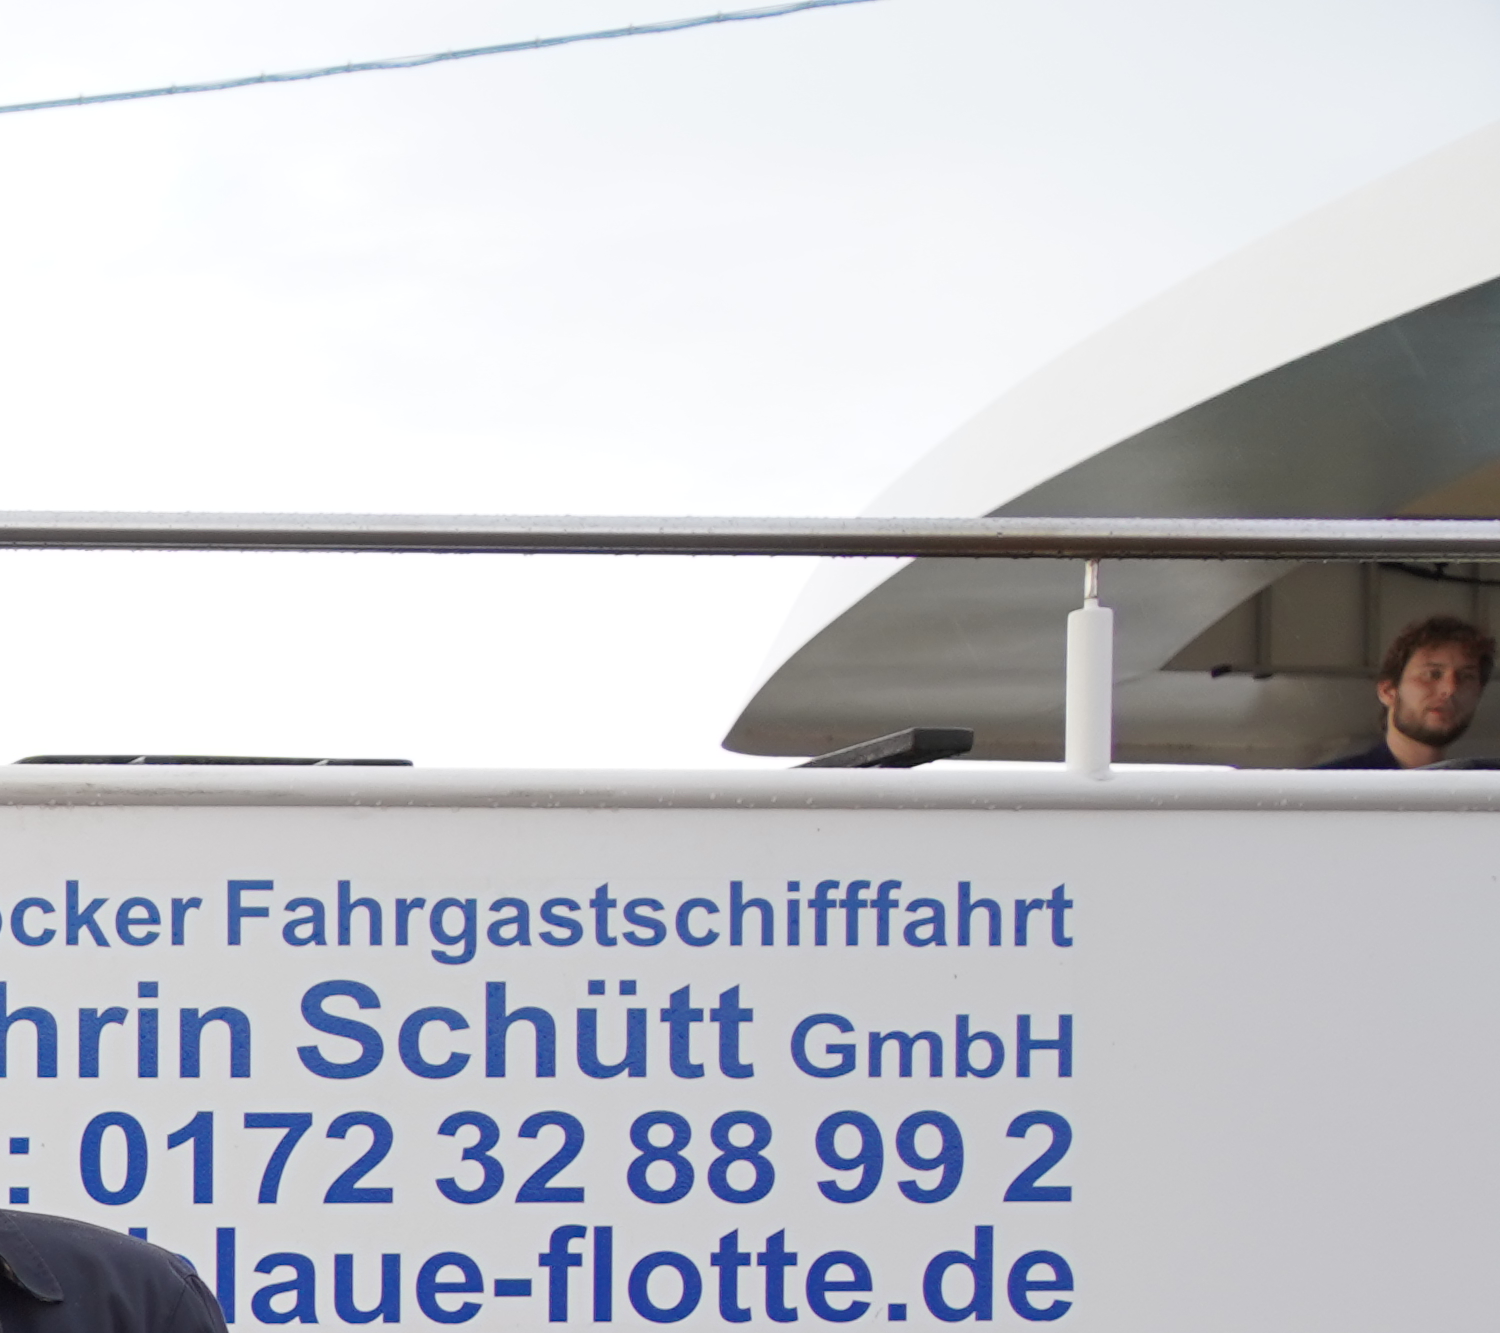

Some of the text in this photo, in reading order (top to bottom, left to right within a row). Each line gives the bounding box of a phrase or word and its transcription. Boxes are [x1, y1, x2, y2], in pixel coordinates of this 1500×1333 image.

[228, 880, 1073, 964] Fahrgastschifffahrt
[298, 980, 754, 1079] Schütt
[791, 1013, 1072, 1078] GmbH
[80, 1111, 393, 1205] 0172
[436, 1110, 584, 1204] 32
[627, 1110, 775, 1203] 88
[816, 1110, 964, 1203] 99
[1004, 1110, 1072, 1201] 2
[129, 1224, 1075, 1325] laue-flotte.de
